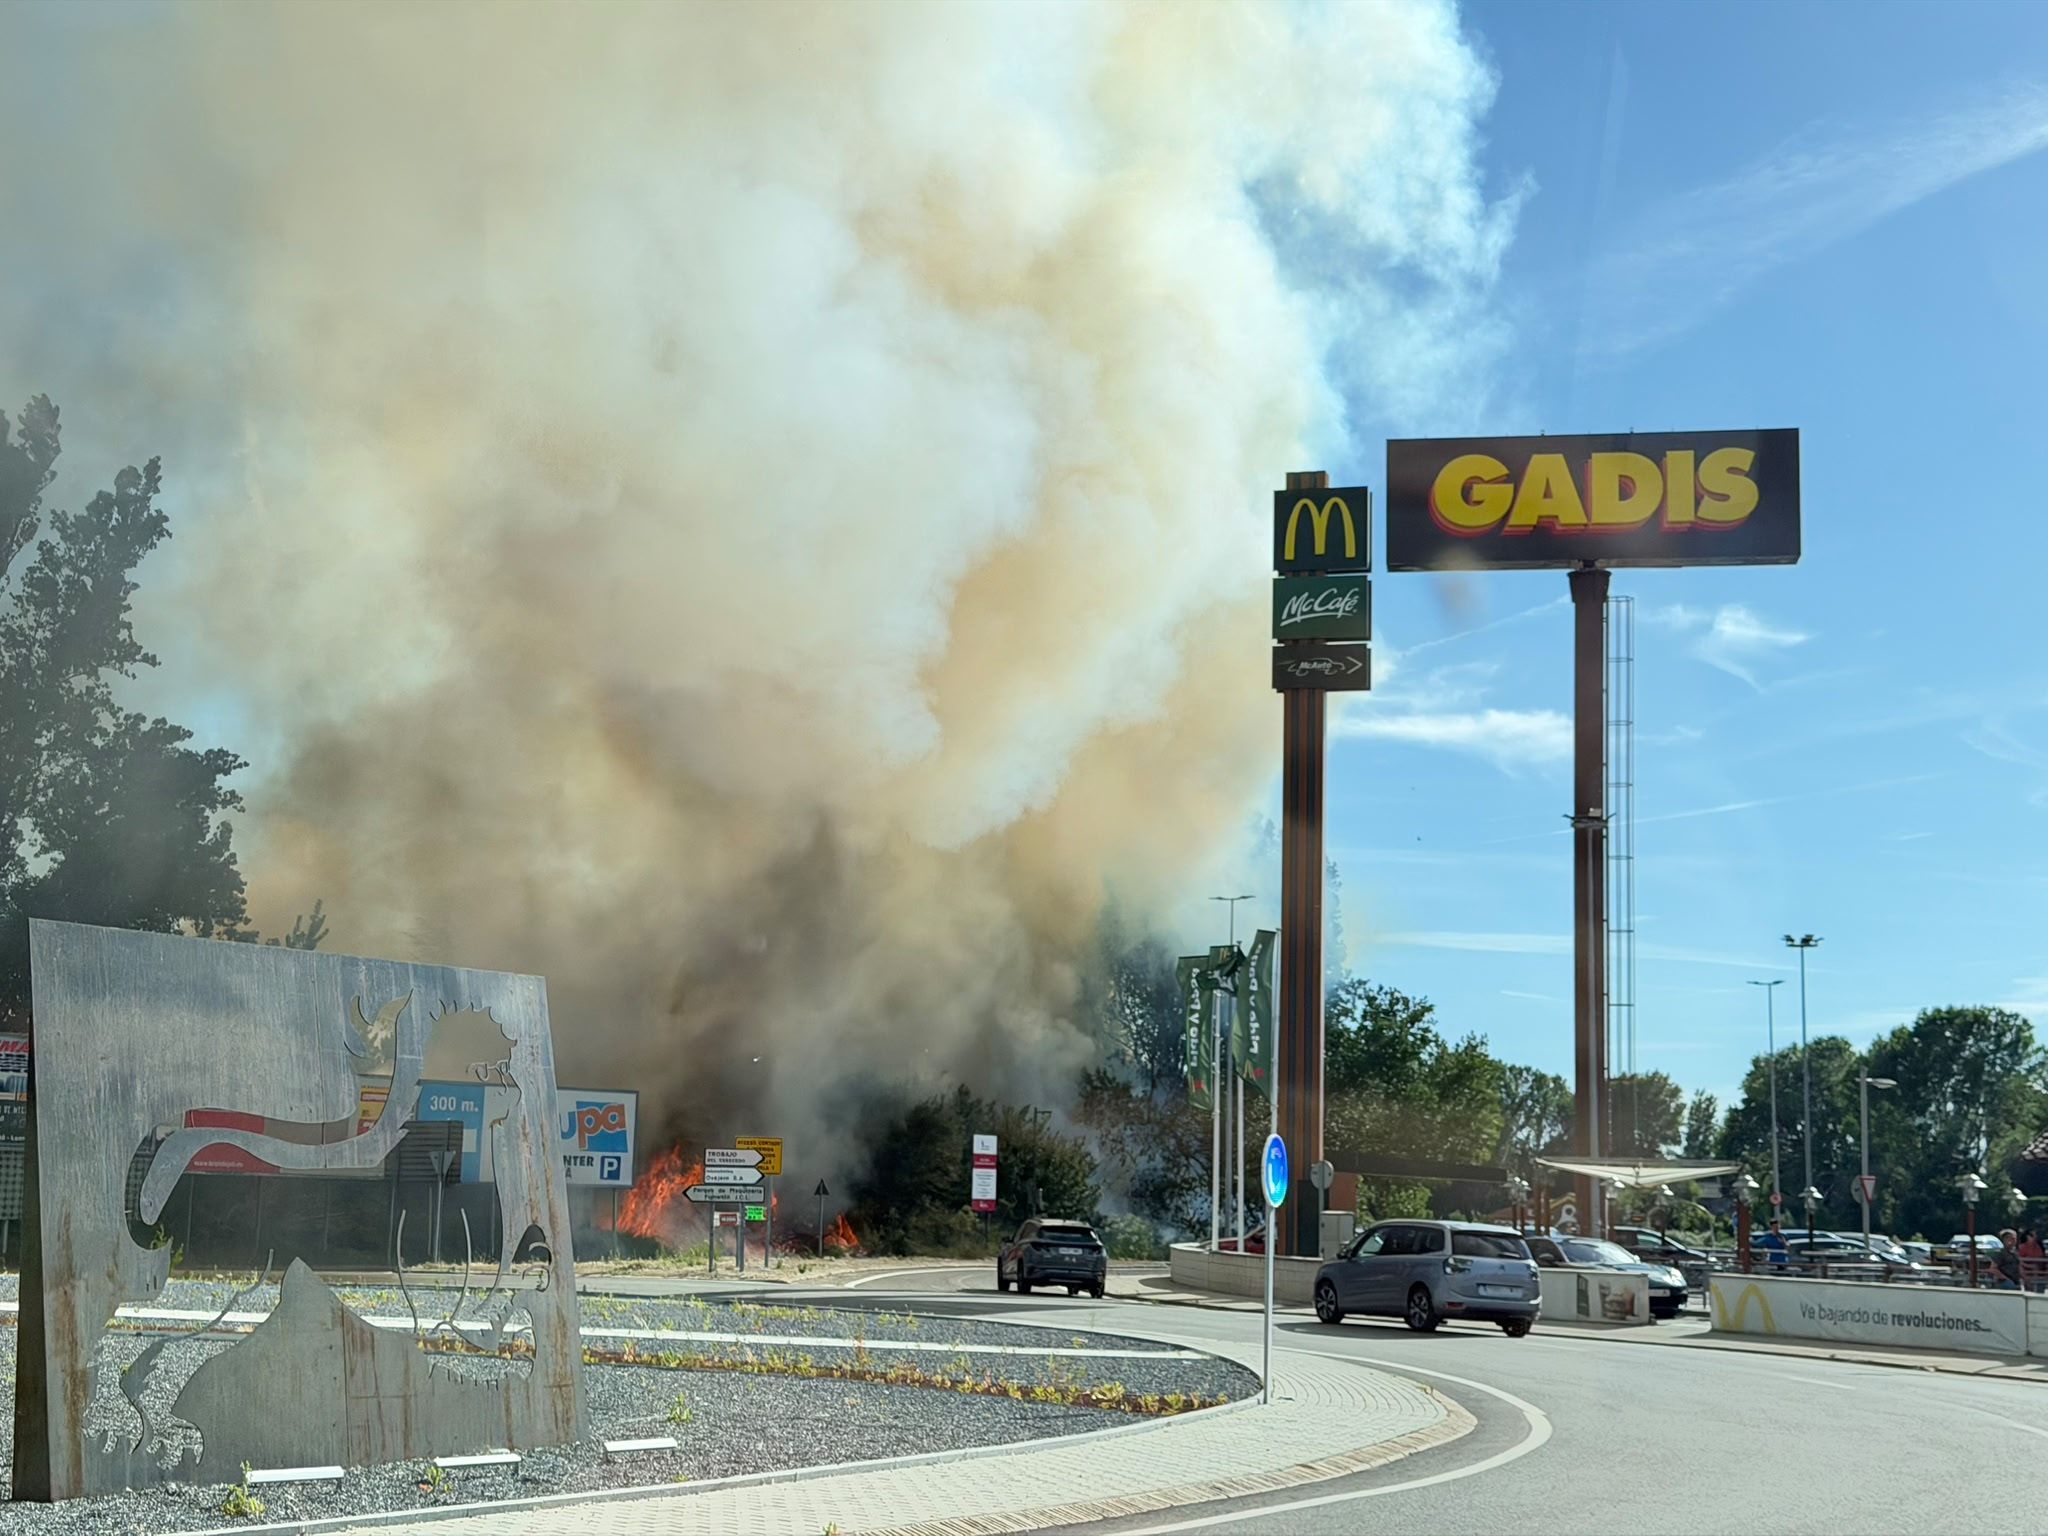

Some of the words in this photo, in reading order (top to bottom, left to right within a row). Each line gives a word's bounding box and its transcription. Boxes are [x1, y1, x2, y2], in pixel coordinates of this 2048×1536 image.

[1429, 447, 1759, 537] GADIS
[1281, 588, 1359, 623] McCafé
[1299, 661, 1333, 669] McAuto
[430, 1095, 456, 1111] 300
[559, 1102, 627, 1150] upa
[563, 1155, 594, 1167] NTER
[603, 1158, 618, 1178] P
[1800, 1303, 1816, 1319] Ve
[1818, 1303, 1870, 1326] bajando
[1872, 1308, 1889, 1326] de
